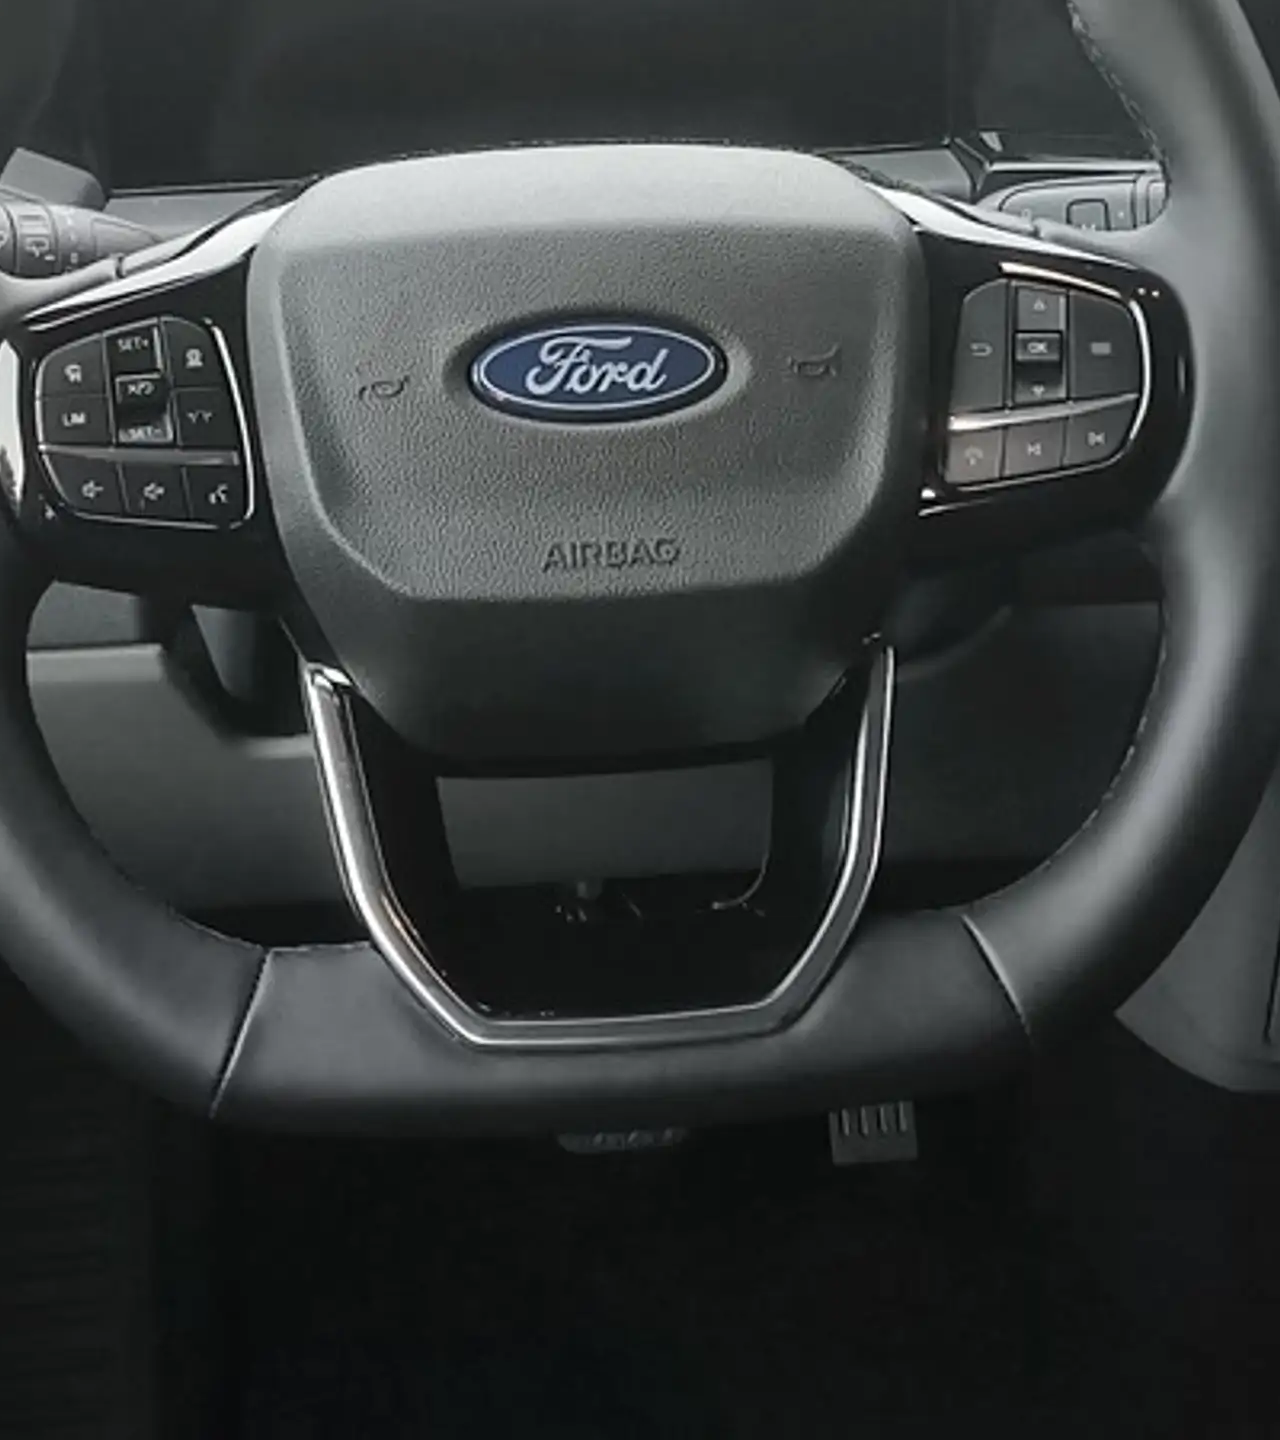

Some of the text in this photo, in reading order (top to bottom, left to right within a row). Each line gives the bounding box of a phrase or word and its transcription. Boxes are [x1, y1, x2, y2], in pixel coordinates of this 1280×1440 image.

[1027, 341, 1049, 354] OK
[524, 335, 669, 396] Ford
[62, 411, 86, 427] LIM
[540, 536, 682, 574] AIRBAG
